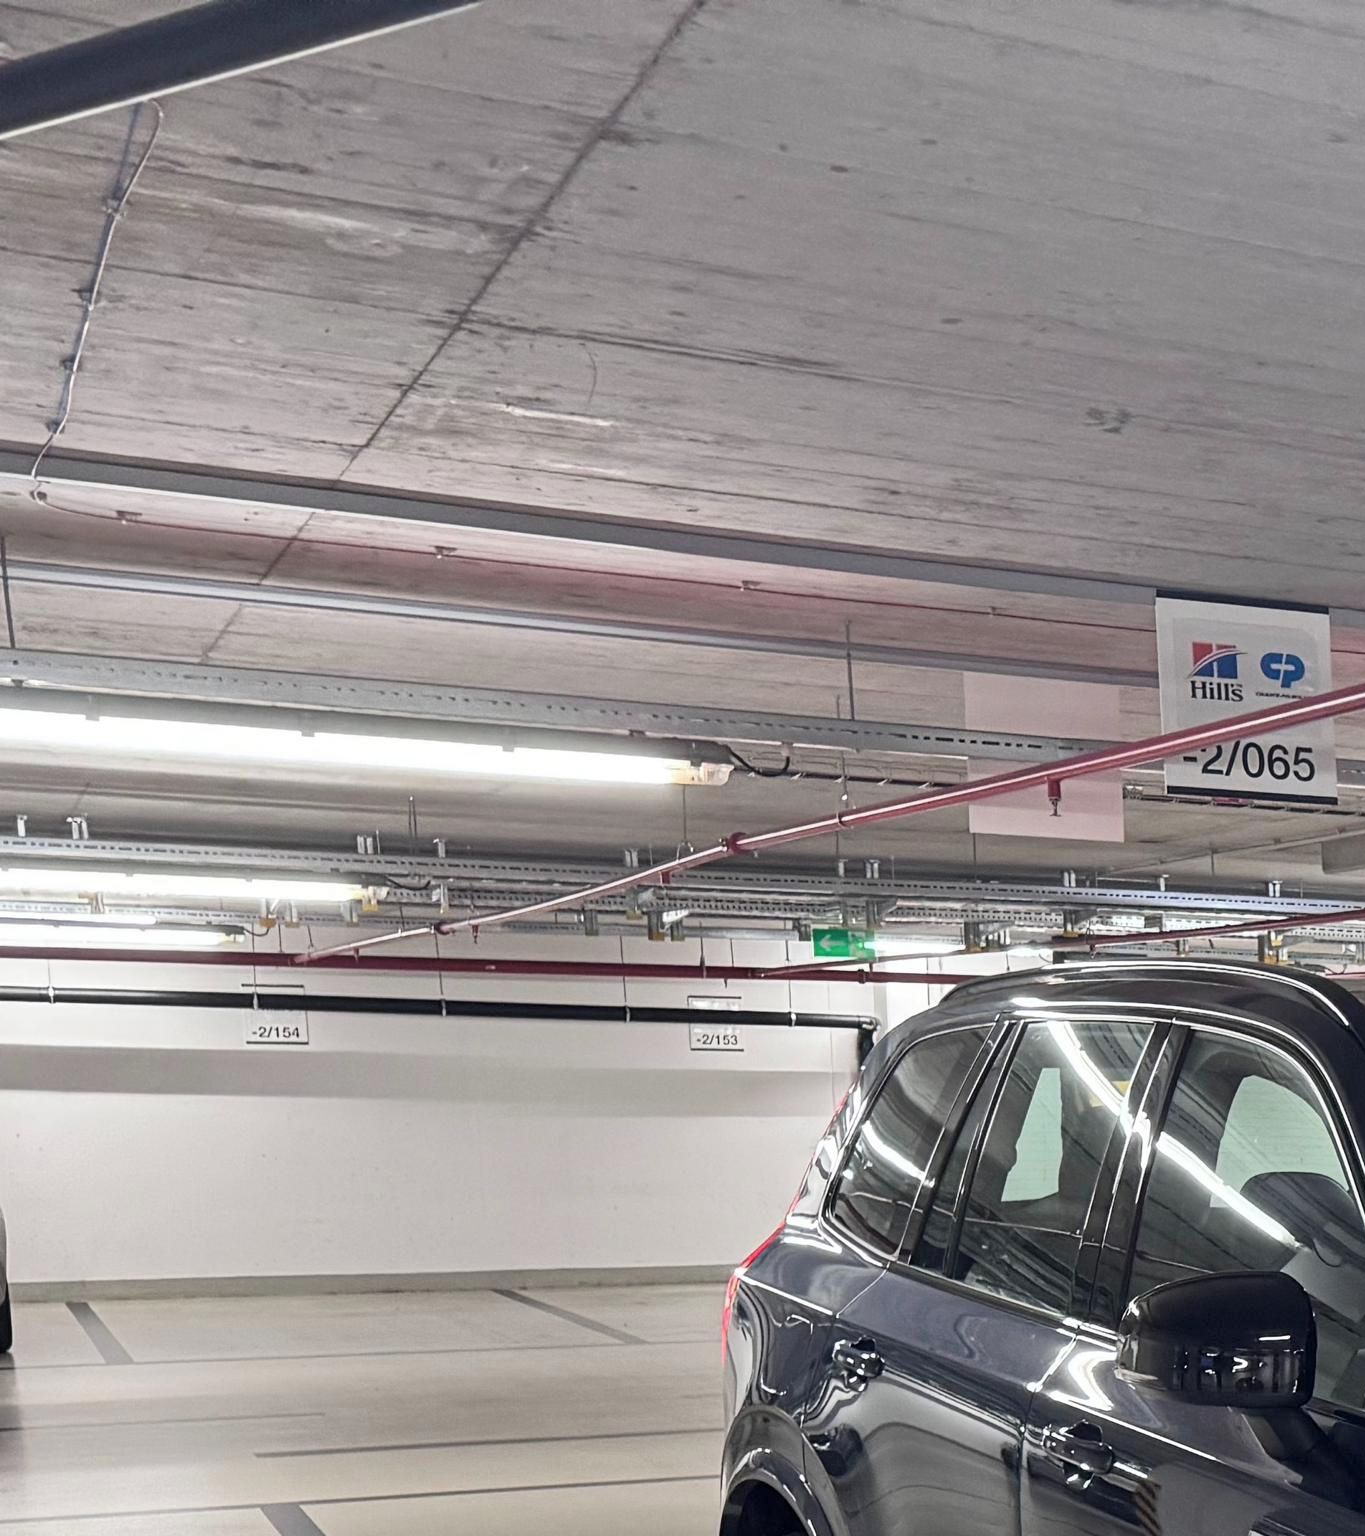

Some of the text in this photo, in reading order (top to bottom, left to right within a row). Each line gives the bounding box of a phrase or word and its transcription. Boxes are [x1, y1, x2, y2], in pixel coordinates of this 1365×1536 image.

[1190, 680, 1244, 702] Hill's
[1183, 740, 1315, 782] -2/065
[251, 1025, 300, 1039] -2/154
[696, 1033, 738, 1046] -2/153
